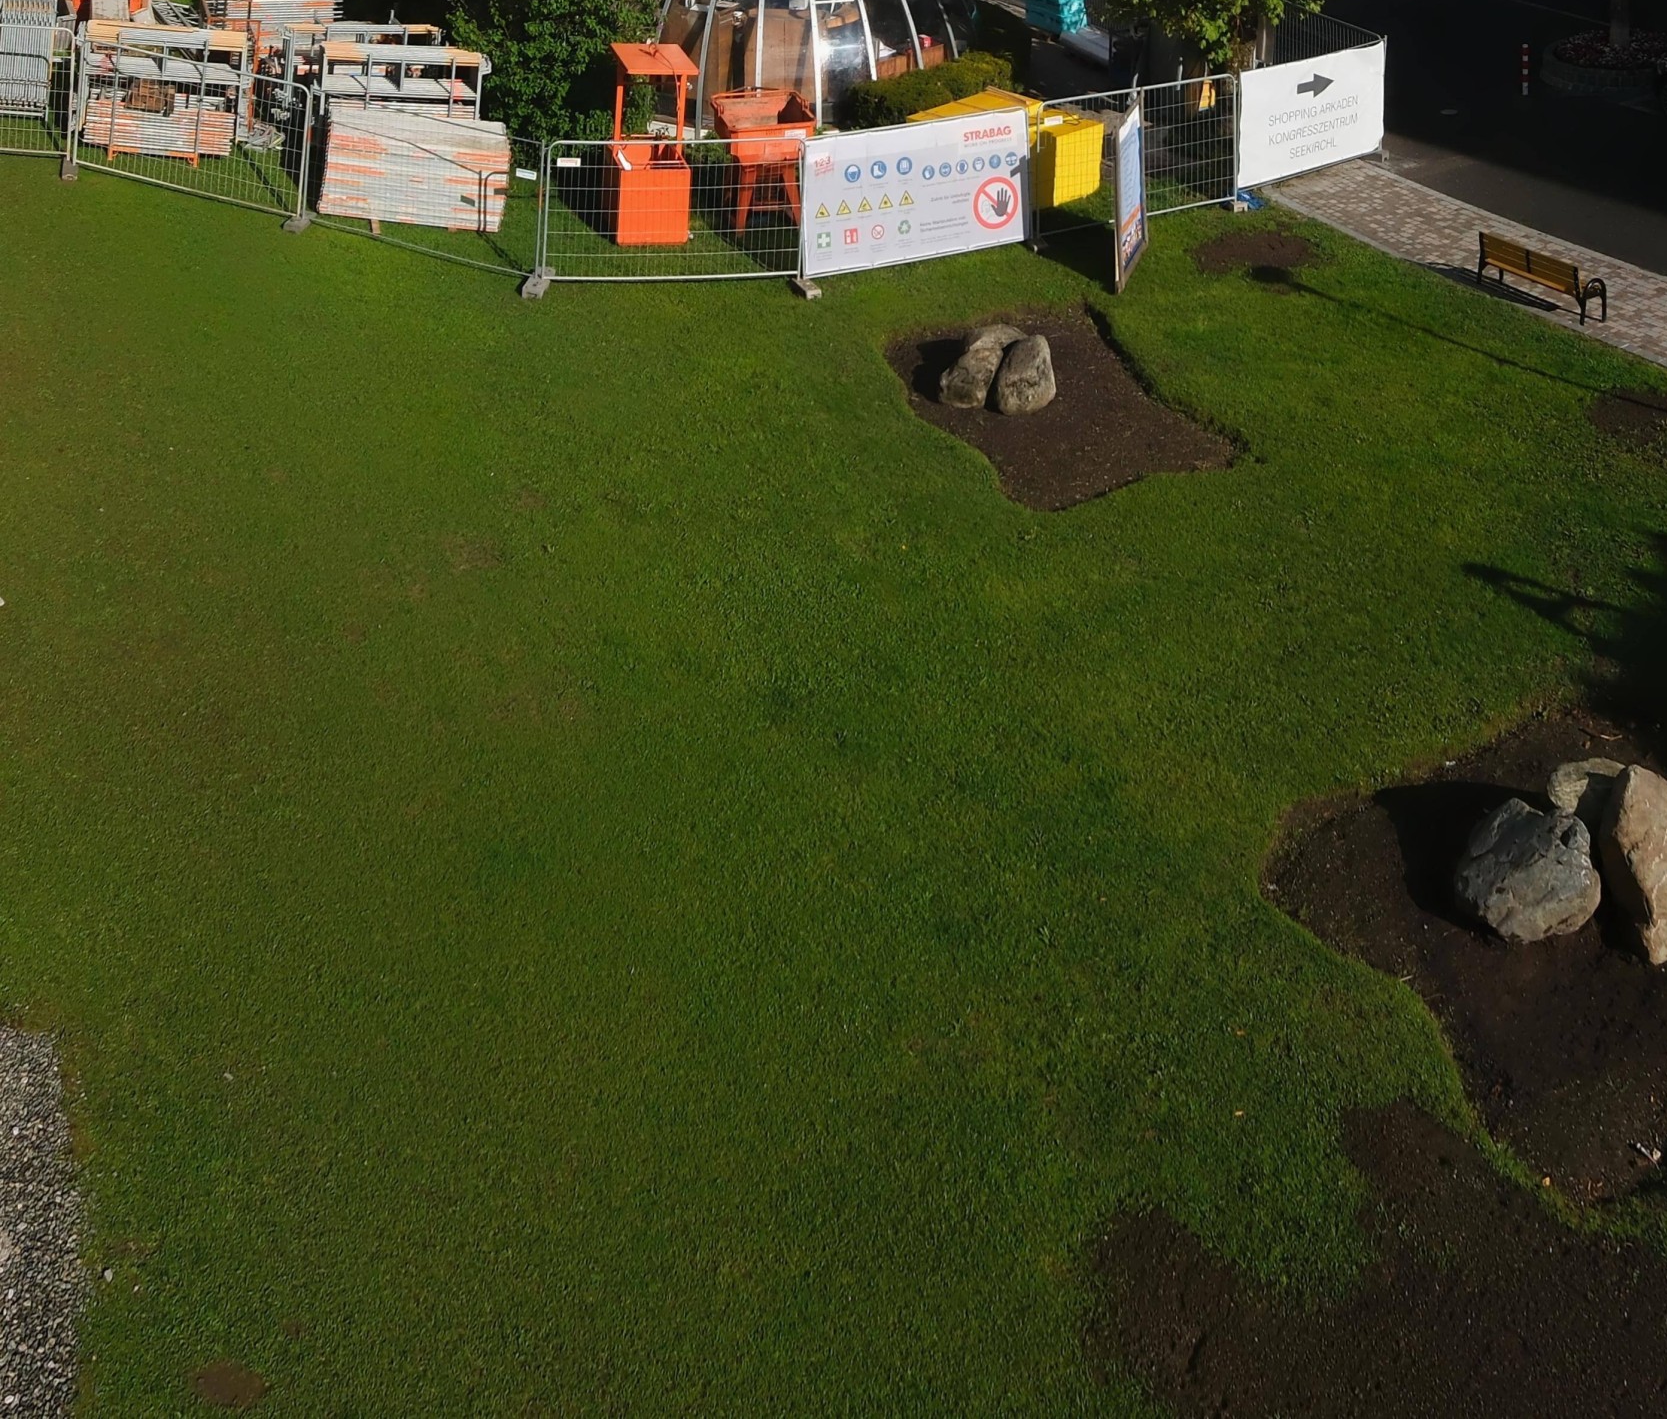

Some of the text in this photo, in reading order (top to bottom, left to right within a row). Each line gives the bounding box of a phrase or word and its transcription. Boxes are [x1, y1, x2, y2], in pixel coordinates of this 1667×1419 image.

[1268, 95, 1359, 127] SHOPPING ARKADEN
[963, 125, 1012, 142] STRABAG
[1268, 113, 1359, 146] KONGRESSZENTRUM
[1289, 138, 1337, 159] SEEKIRCHL
